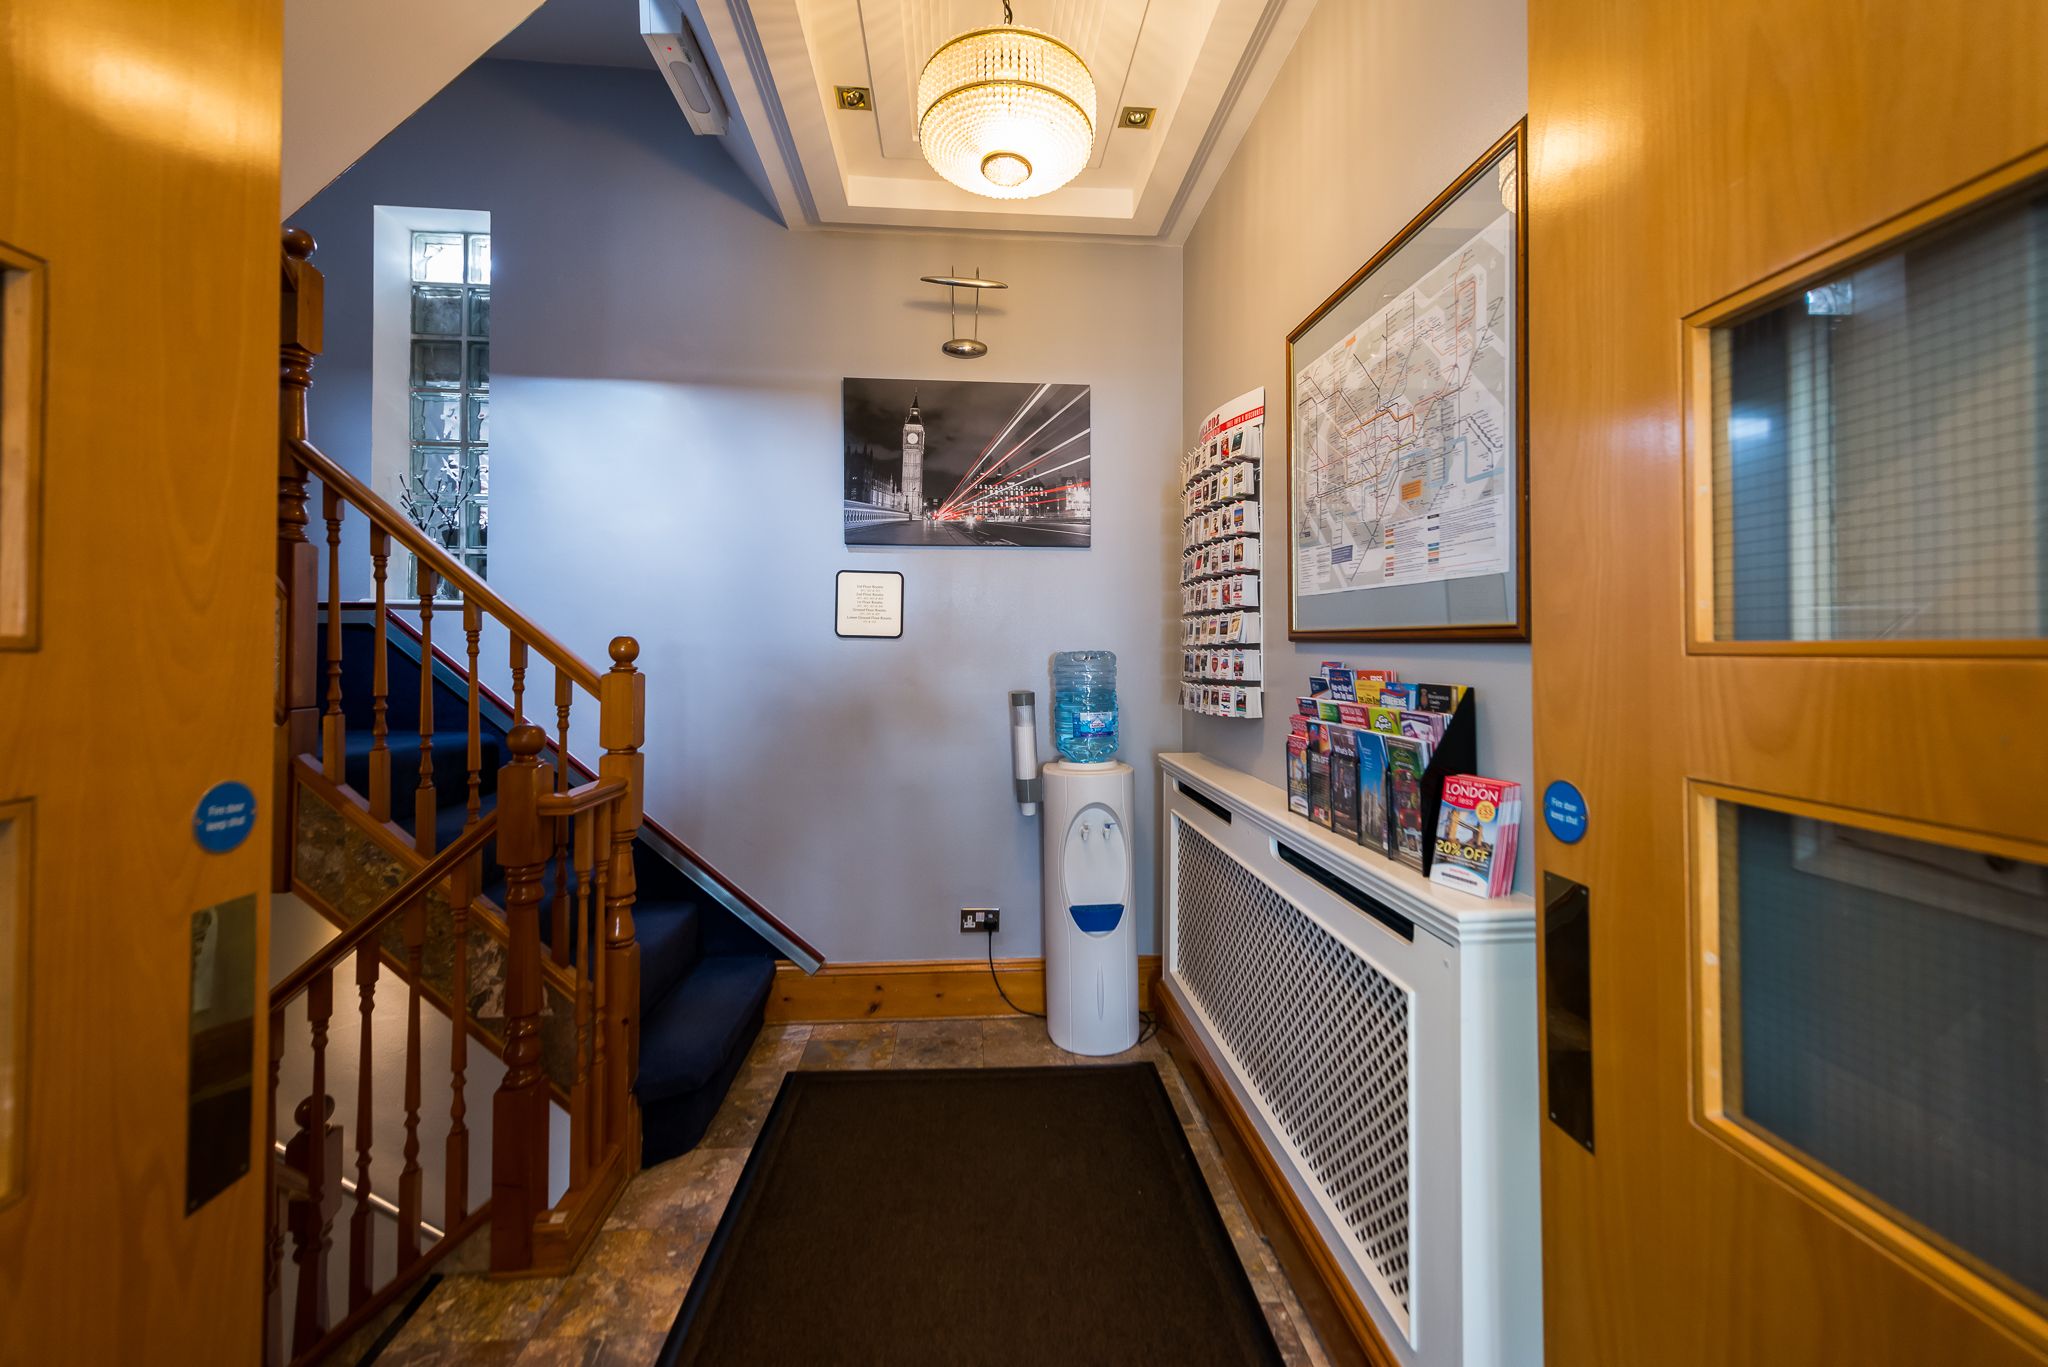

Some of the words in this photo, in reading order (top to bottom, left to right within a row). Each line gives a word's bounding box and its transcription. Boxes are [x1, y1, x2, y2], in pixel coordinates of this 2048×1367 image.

[1445, 782, 1499, 803] LONDON
[208, 805, 225, 816] Fire
[227, 802, 245, 814] door
[1551, 797, 1563, 808] Fire
[1564, 802, 1577, 812] door
[1436, 839, 1462, 857] 20%
[1463, 847, 1489, 862] OFF
